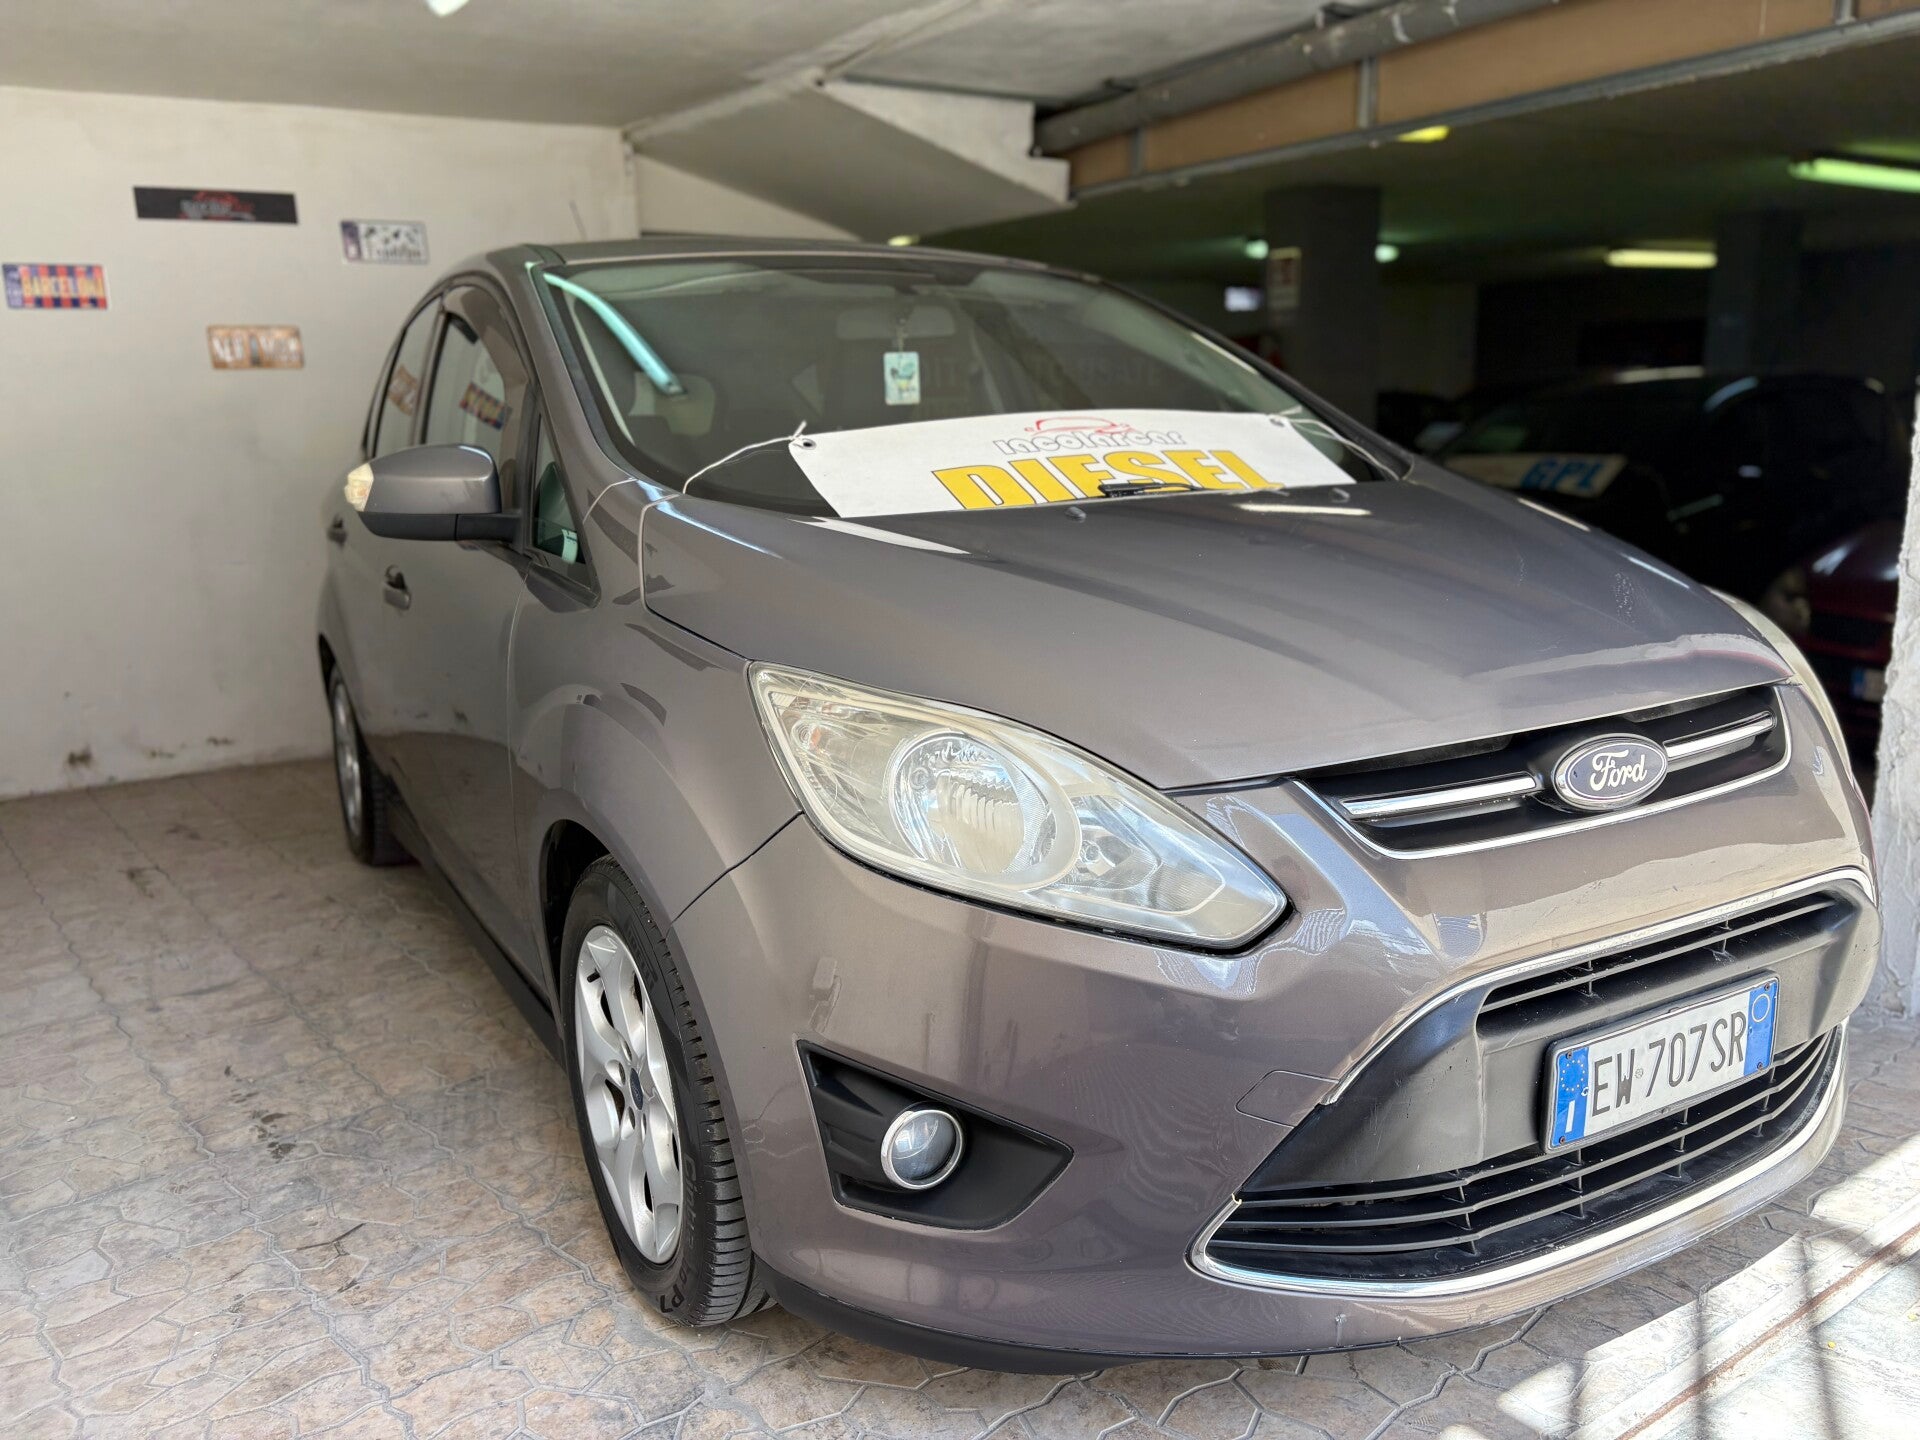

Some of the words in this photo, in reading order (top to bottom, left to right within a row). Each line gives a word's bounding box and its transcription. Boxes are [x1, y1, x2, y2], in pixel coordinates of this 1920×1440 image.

[931, 450, 1284, 510] DIESEL
[1590, 749, 1647, 791] Ford
[1592, 1048, 1636, 1117] EW
